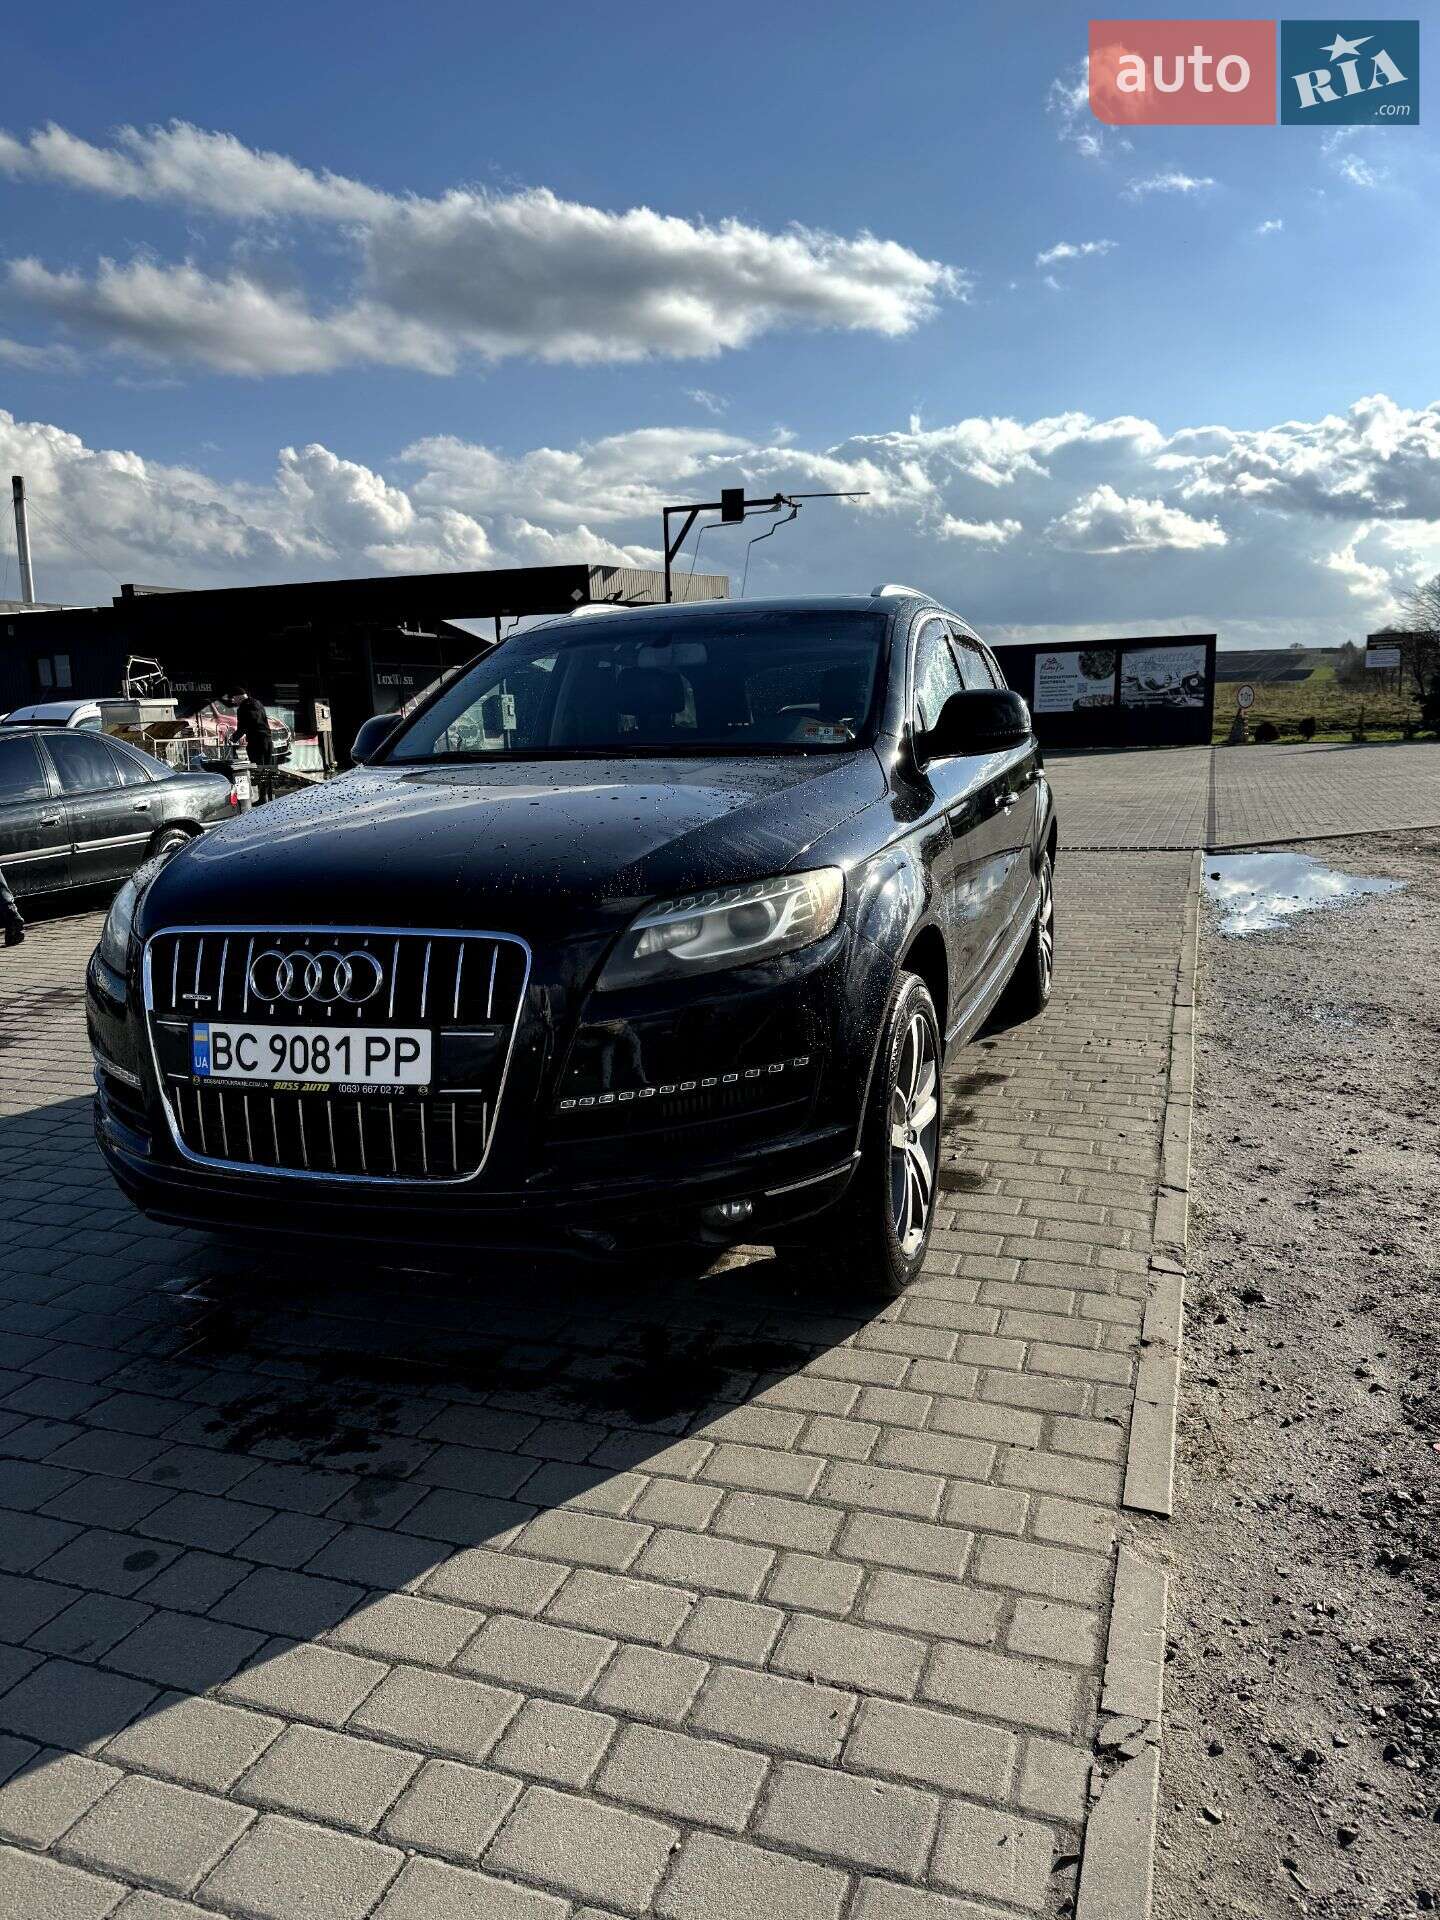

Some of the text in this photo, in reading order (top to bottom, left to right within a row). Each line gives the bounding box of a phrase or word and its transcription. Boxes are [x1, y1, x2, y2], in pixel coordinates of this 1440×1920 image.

[212, 1031, 421, 1077] BC 9081 PP
[195, 1056, 209, 1069] UA
[273, 1081, 299, 1091] BOSS
[338, 1084, 360, 1093] (063)
[362, 1085, 379, 1094] 667
[380, 1085, 392, 1094] 02
[393, 1085, 405, 1095] 72
